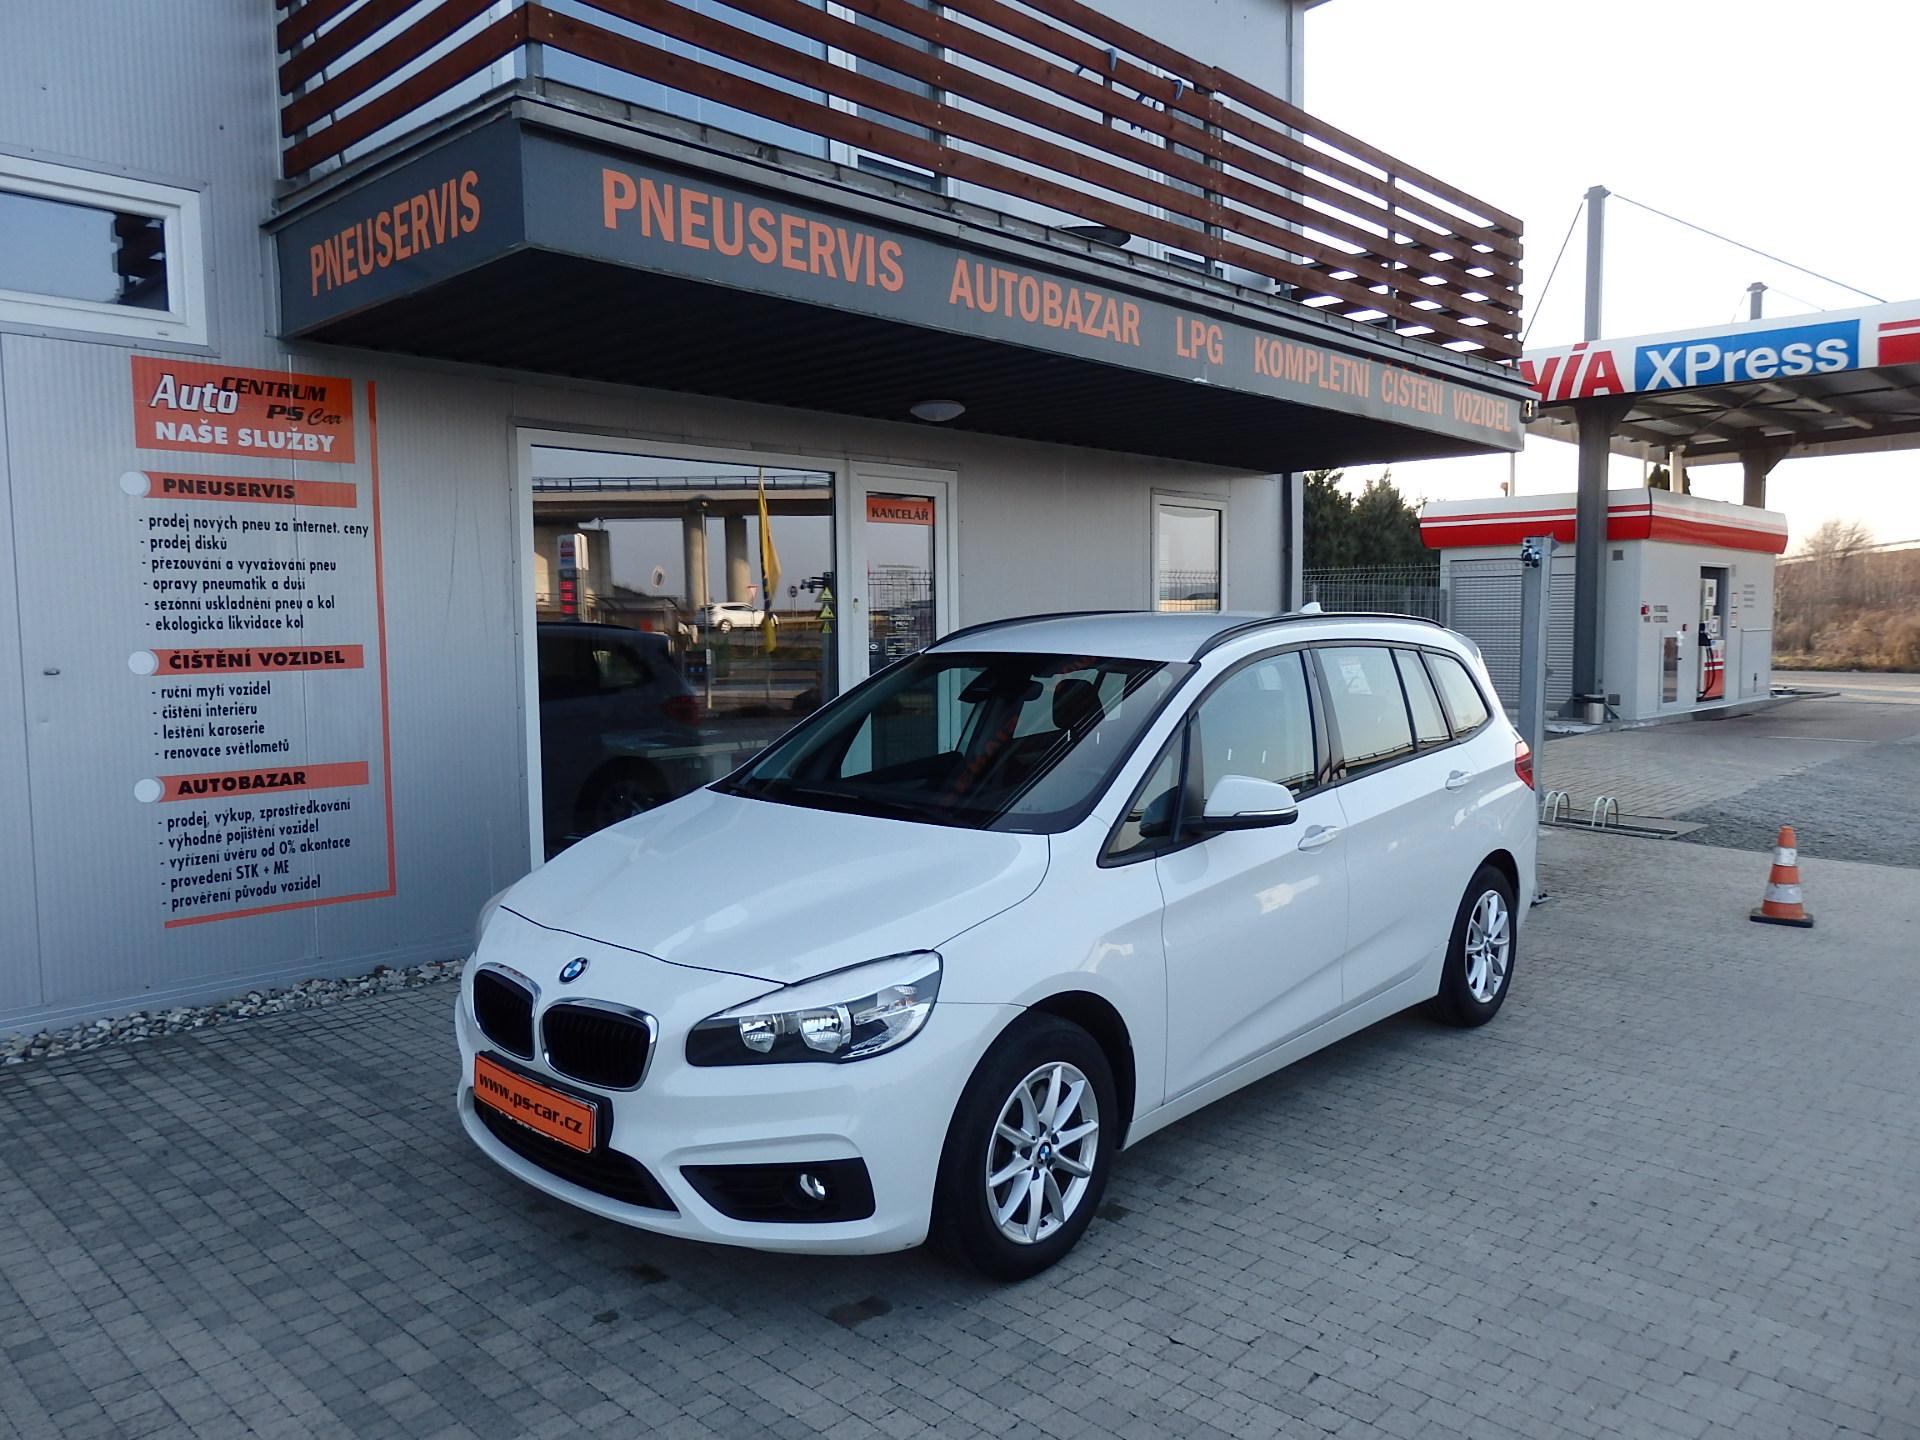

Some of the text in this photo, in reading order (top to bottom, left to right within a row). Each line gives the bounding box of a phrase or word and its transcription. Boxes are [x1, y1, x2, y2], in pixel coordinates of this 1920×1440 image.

[310, 170, 480, 296] PNEUSERVIS
[602, 168, 904, 293] PNEUSERVIS
[949, 258, 1140, 347] AUTOBAZAR
[1176, 315, 1225, 366] LPG
[1254, 336, 1371, 398] KOMPLETNÍ
[1453, 388, 1512, 432] VOZIDEL
[1643, 338, 1850, 392] XPress
[149, 373, 327, 415] Auto CENTRUM
[266, 404, 343, 426] PS Car
[155, 418, 336, 453] NAŠE SLUŽBY
[163, 478, 296, 499] PNEUSERVIS
[149, 513, 369, 538] prodej nových pneu za internet. ceny
[872, 507, 929, 521] KANCELÁŘ
[150, 534, 191, 553] prodej
[152, 556, 337, 574] přezouvání a vyvažování pneu
[153, 580, 197, 594] opravy
[203, 576, 267, 594] pneumatik
[271, 580, 279, 590] a
[154, 595, 335, 613] sezónní uskladnění pneu a kol
[155, 614, 304, 634] ekologická likvidace kol
[169, 649, 345, 669] ČIŠTĚNÍ VOZIDEL
[161, 680, 271, 701] ruční mytí vozidel
[162, 702, 257, 719] čištění interiéru
[163, 720, 265, 739] leštění karoserie
[164, 739, 290, 760] renovace světlometů
[178, 771, 306, 795] AUTOBAZAR
[167, 798, 351, 833] prodej, výkup, zprostředkování
[168, 818, 319, 852] výhodné pojištění vozidel
[170, 838, 351, 872] vyřízení úvěru od 0% akontace
[171, 860, 289, 893] provedení STK + ME
[172, 874, 320, 912] prověření původu vozidel
[480, 1073, 583, 1134] www.ps-car.cz
